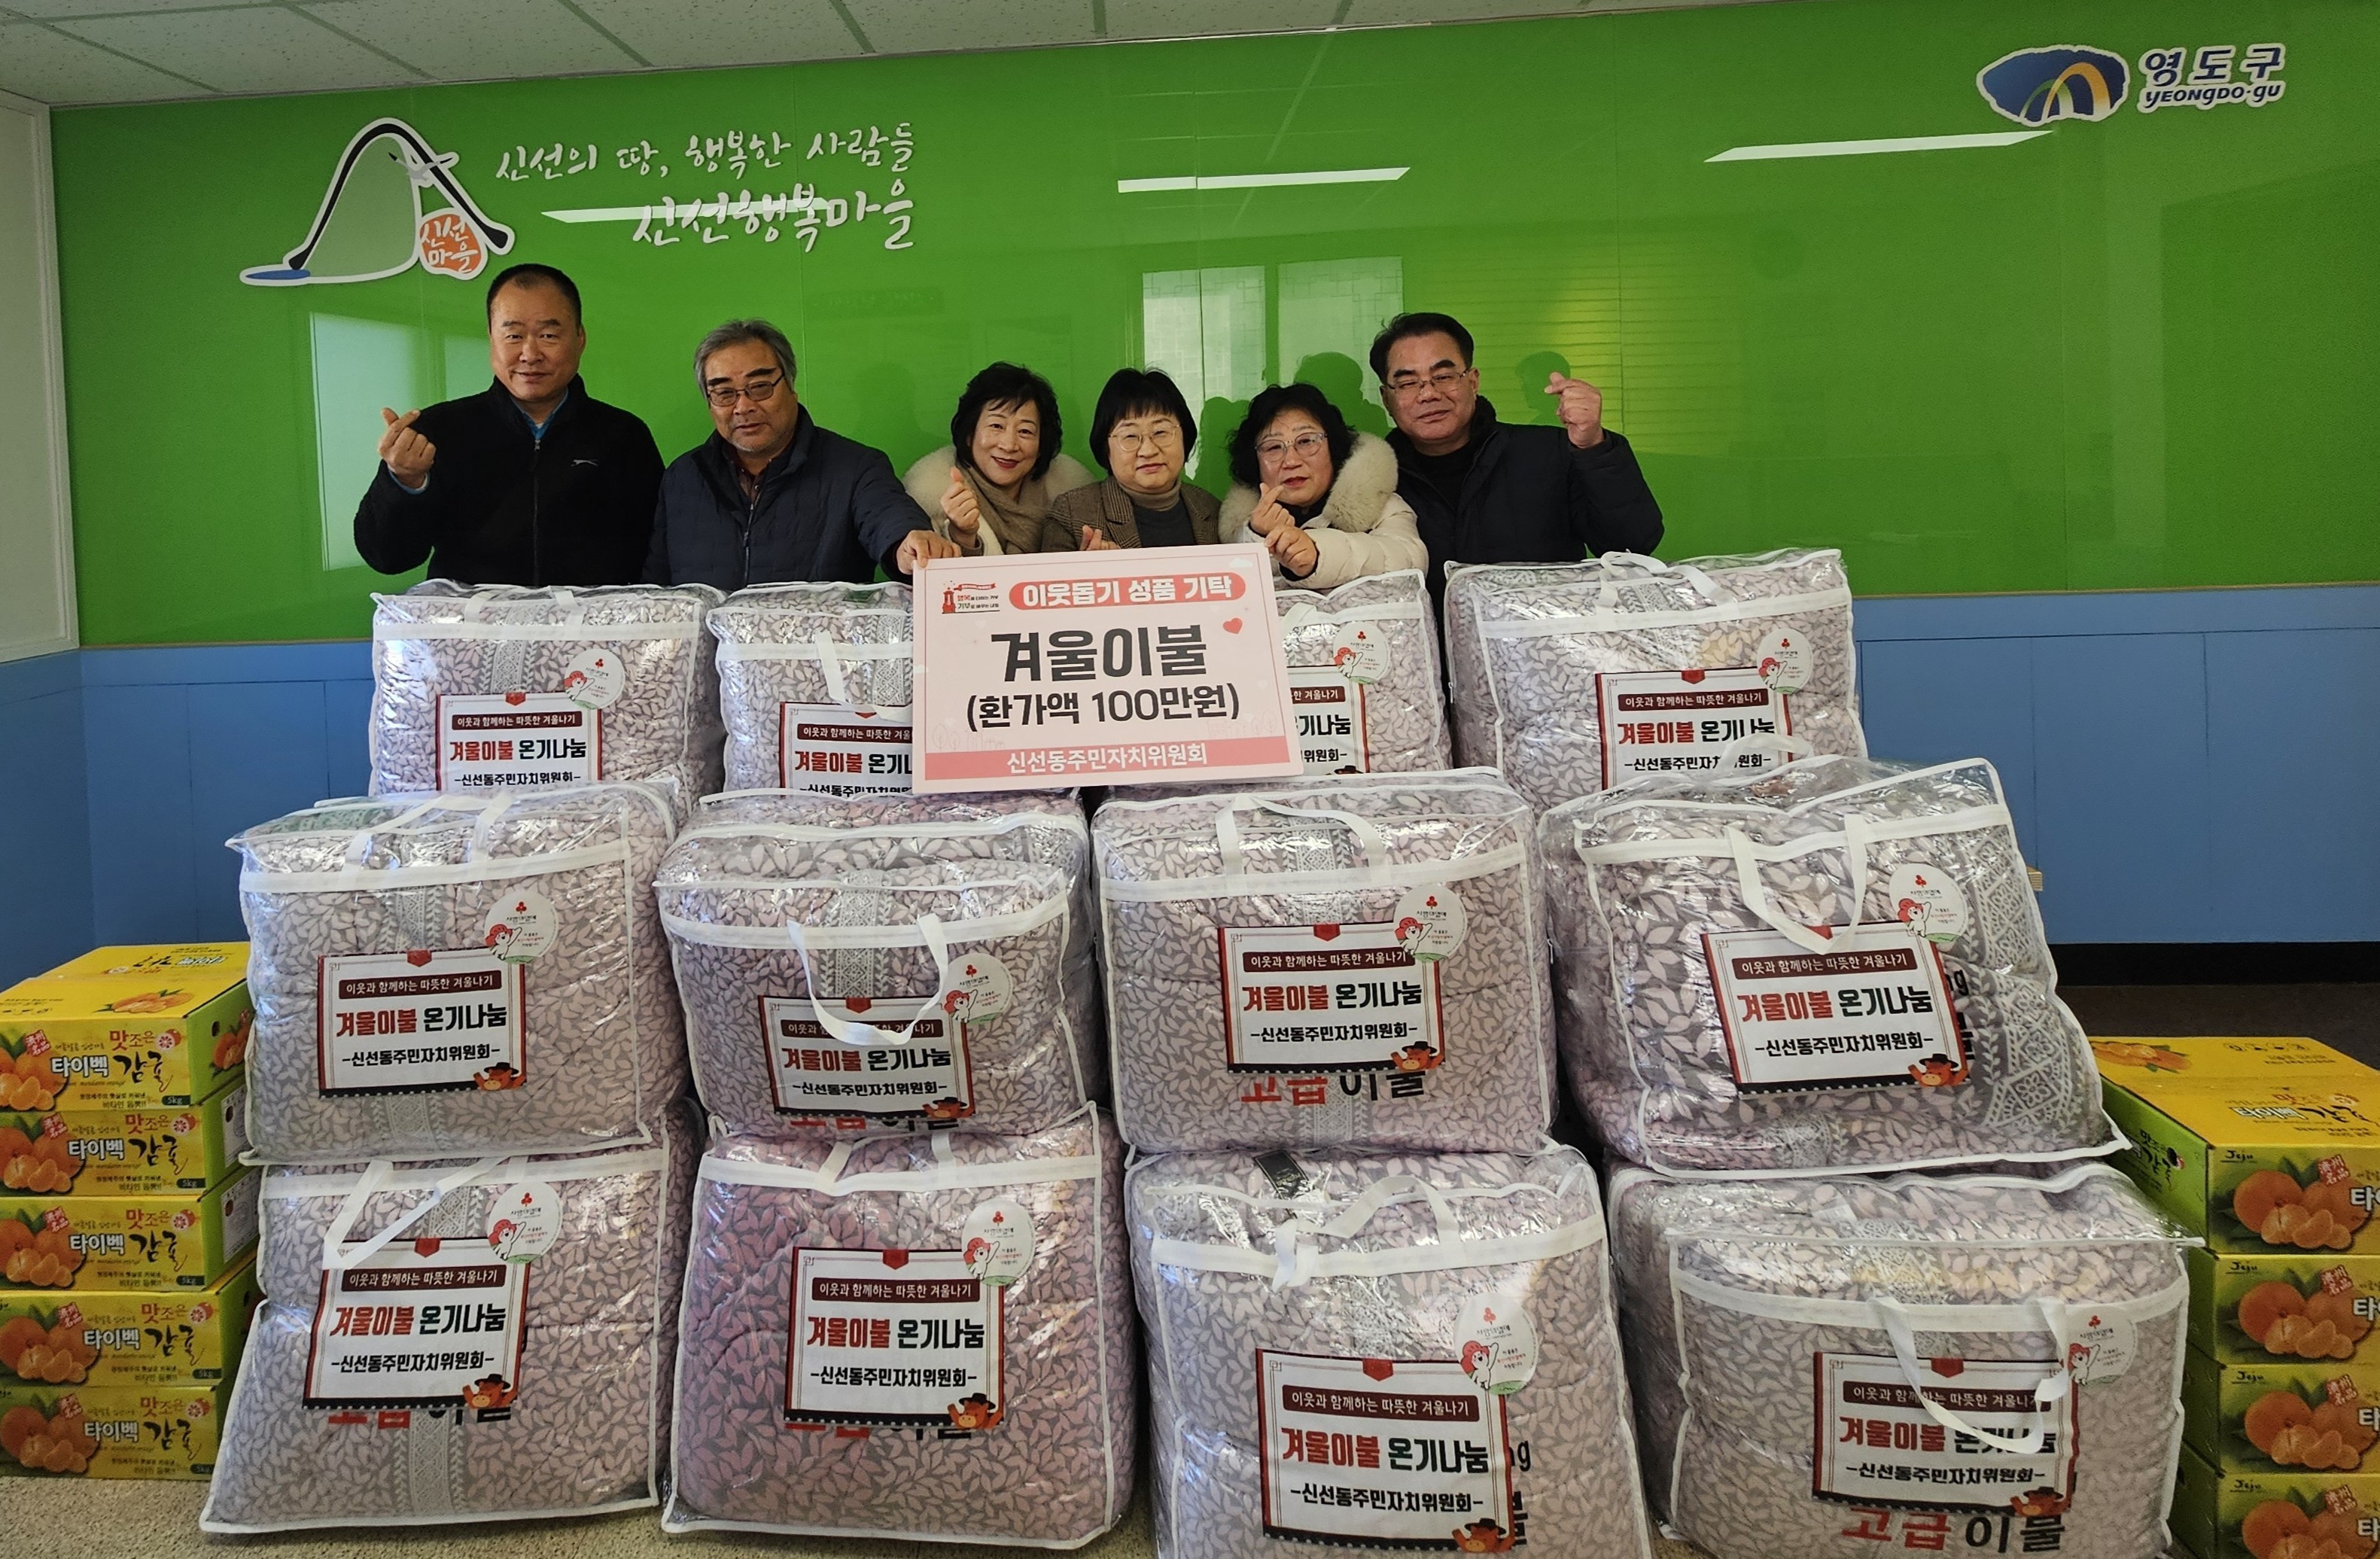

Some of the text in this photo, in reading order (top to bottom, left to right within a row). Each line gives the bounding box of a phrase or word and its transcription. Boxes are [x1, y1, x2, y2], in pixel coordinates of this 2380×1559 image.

[2145, 47, 2281, 87] 영도구
[495, 143, 598, 181] 신선의
[685, 130, 790, 180] 행복한
[807, 121, 916, 172] 사람들
[632, 180, 916, 251] 신선행복마을
[421, 216, 469, 246] 신선
[428, 243, 479, 273] 마을
[1023, 574, 1231, 606] 이웃돕기 성품 기탁
[991, 624, 1207, 682] 겨울이불
[1305, 690, 1338, 700] 겨울나기
[1626, 693, 1761, 707] 이웃과 함께하는 따뜻한 겨울나기
[967, 682, 1240, 733] (환가액 100만원)
[457, 715, 576, 727] 이웃과 함께하는 따뜻한 겨울나기
[1295, 714, 1351, 735] 기나눔
[803, 727, 828, 738] 이웃과
[831, 728, 864, 738] 함께하는
[866, 729, 891, 740] 따뜻한
[1618, 721, 1694, 744] 겨울이불
[449, 738, 586, 761] 겨울이불 온기나눔
[1007, 742, 1208, 776] 신선동주민자치위원회
[795, 751, 862, 773] 겨울이불
[1251, 952, 1406, 968] 이웃과 함께하는 따뜻한 겨울나기
[1742, 954, 1907, 975] 이웃과 함께하는 따뜻한 겨울나기
[346, 975, 492, 994] 이웃과 함께하는 따뜻한 겨울나기
[1243, 980, 1422, 1011] 겨울이불 온기나눔
[1737, 986, 1933, 1022] 겨울이불 온기나눔
[336, 1003, 507, 1037] 겨울이불 온기나눔
[788, 1025, 817, 1034] 이웃과
[109, 1030, 154, 1051] 맛조은
[50, 1054, 109, 1078] 타이벡
[781, 1048, 951, 1071] 겨울이불 온기나눔
[68, 1139, 124, 1161] 타이벡
[2226, 1149, 2254, 1162] Jeju
[69, 1233, 125, 1255] 타이벡
[349, 1269, 497, 1287] 이웃과 함께하는 따뜻한 겨울나기
[2230, 1261, 2257, 1273] Jeju
[820, 1283, 972, 1298] 이웃과 함께하는 따뜻한 겨울나기
[330, 1304, 507, 1336] 겨울이불 온기나눔
[84, 1329, 140, 1350] 타이벡
[807, 1317, 985, 1350] 겨울이불 온기나눔
[2236, 1371, 2264, 1383] Jeju
[1292, 1392, 1468, 1417] 이웃과 함께하는 따뜻한 겨울나기
[1853, 1387, 1891, 1401] 이웃과
[1949, 1393, 1987, 1408] 따뜻한
[84, 1422, 138, 1442] 타이벡
[1840, 1417, 1946, 1452] 겨울이불
[1281, 1427, 1380, 1469] 겨울이불
[1388, 1437, 1489, 1474] 온기나눔
[2235, 1479, 2262, 1491] Jeju
[1842, 1507, 1952, 1550] 고급
